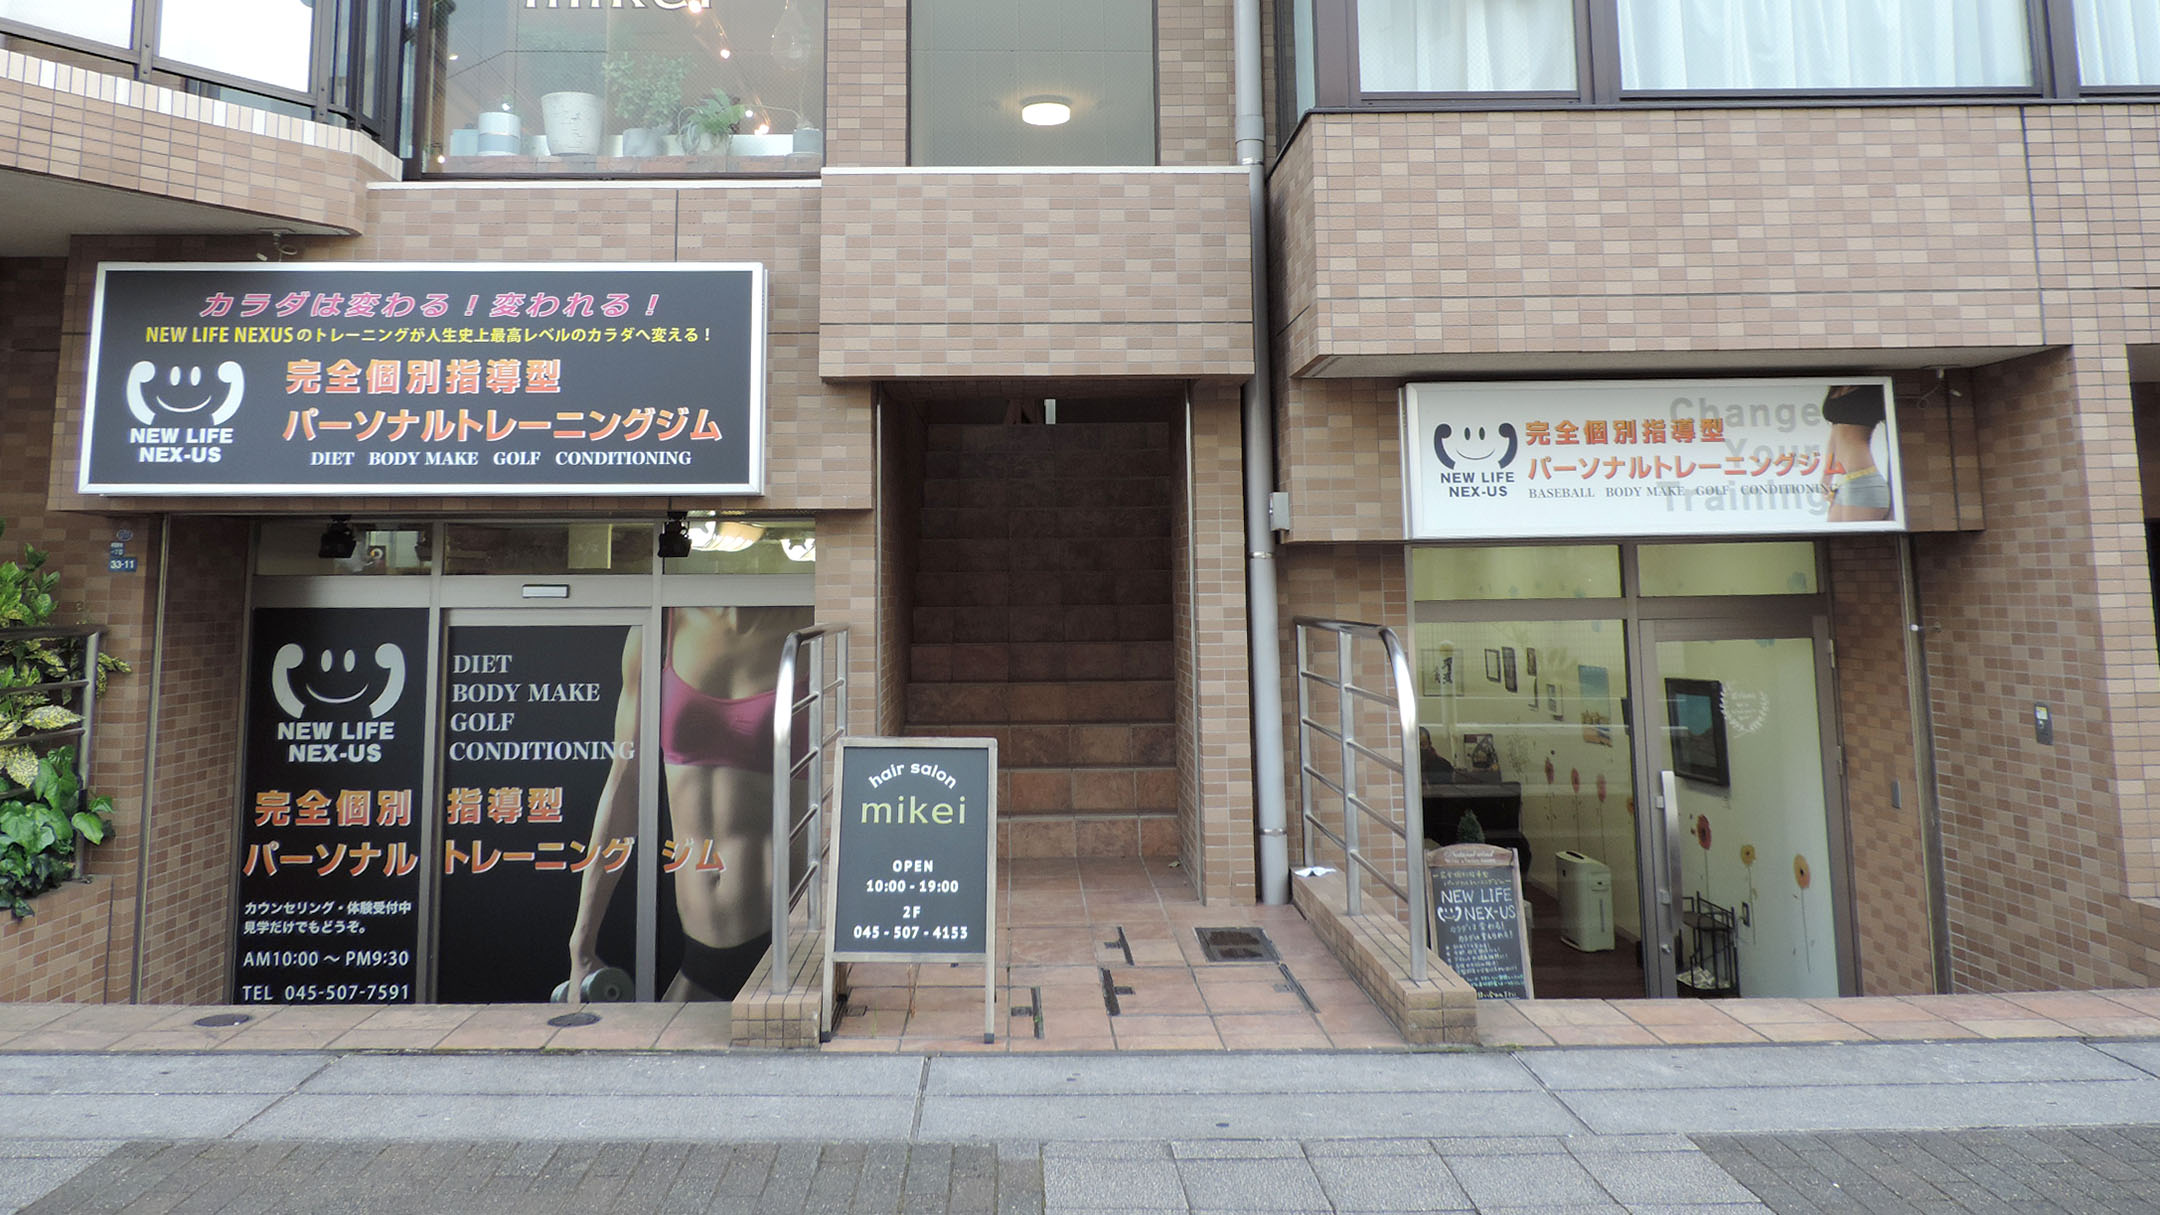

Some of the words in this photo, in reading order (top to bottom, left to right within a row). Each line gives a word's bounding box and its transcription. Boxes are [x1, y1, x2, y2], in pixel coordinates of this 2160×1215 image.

[199, 290, 660, 318] カラダは変わる！変われる！
[145, 326, 189, 343] NEW
[192, 326, 230, 343] LIFE
[285, 358, 562, 395] 完全個別指導型
[1669, 397, 1821, 432] Change
[282, 406, 723, 442] パーソナルトレーニングジム
[1525, 417, 1725, 446] 完全個別指導型
[129, 427, 180, 444] NEW
[185, 427, 234, 444] LIFE
[138, 446, 222, 463] NEX-US
[310, 451, 355, 466] DIET
[368, 451, 422, 466] BODY
[424, 451, 479, 466] MAKE
[493, 451, 541, 466] GOLF
[555, 450, 692, 466] CONDITIONING
[1528, 451, 1847, 480] パーソナルトレーニングジム
[1440, 472, 1475, 483] NEW
[1481, 471, 1515, 483] LIFE
[1448, 486, 1508, 498] NEX-US
[1528, 488, 1595, 499] BASEBALL
[1605, 487, 1642, 498] BODY
[1646, 486, 1685, 497] MAKE
[1695, 485, 1729, 497] GOLF
[452, 654, 513, 674] DIET
[452, 683, 523, 703] BODY
[527, 682, 601, 702] MAKE
[277, 721, 333, 740] NEW
[340, 721, 395, 740] LIFE
[450, 712, 515, 732] GOLF
[287, 743, 383, 763] NEX-US
[449, 741, 636, 762] CONDITIONING
[868, 763, 905, 789] hair
[910, 762, 957, 789] salon
[254, 789, 412, 827] 完全個別
[446, 786, 564, 825] 指導型
[861, 795, 966, 824] mikei
[242, 840, 419, 877] パーソナル
[444, 837, 636, 875] トレーニング
[661, 837, 726, 874] ジム
[892, 859, 934, 872] OPEN
[866, 879, 906, 893] 10:00
[919, 879, 959, 893] 19:00
[1441, 889, 1474, 904] NEW
[1480, 887, 1512, 903] LIFE
[244, 900, 412, 915] カウンセリング・体験受付中
[902, 906, 921, 919] 2F
[1464, 904, 1516, 921] NEX-US
[243, 920, 366, 935] 見学だけでもどうぞ。
[242, 951, 319, 967] AM10:00
[345, 950, 410, 966] PM9:30
[242, 985, 274, 1001] TEL
[284, 984, 410, 1001] 045-507-7591
